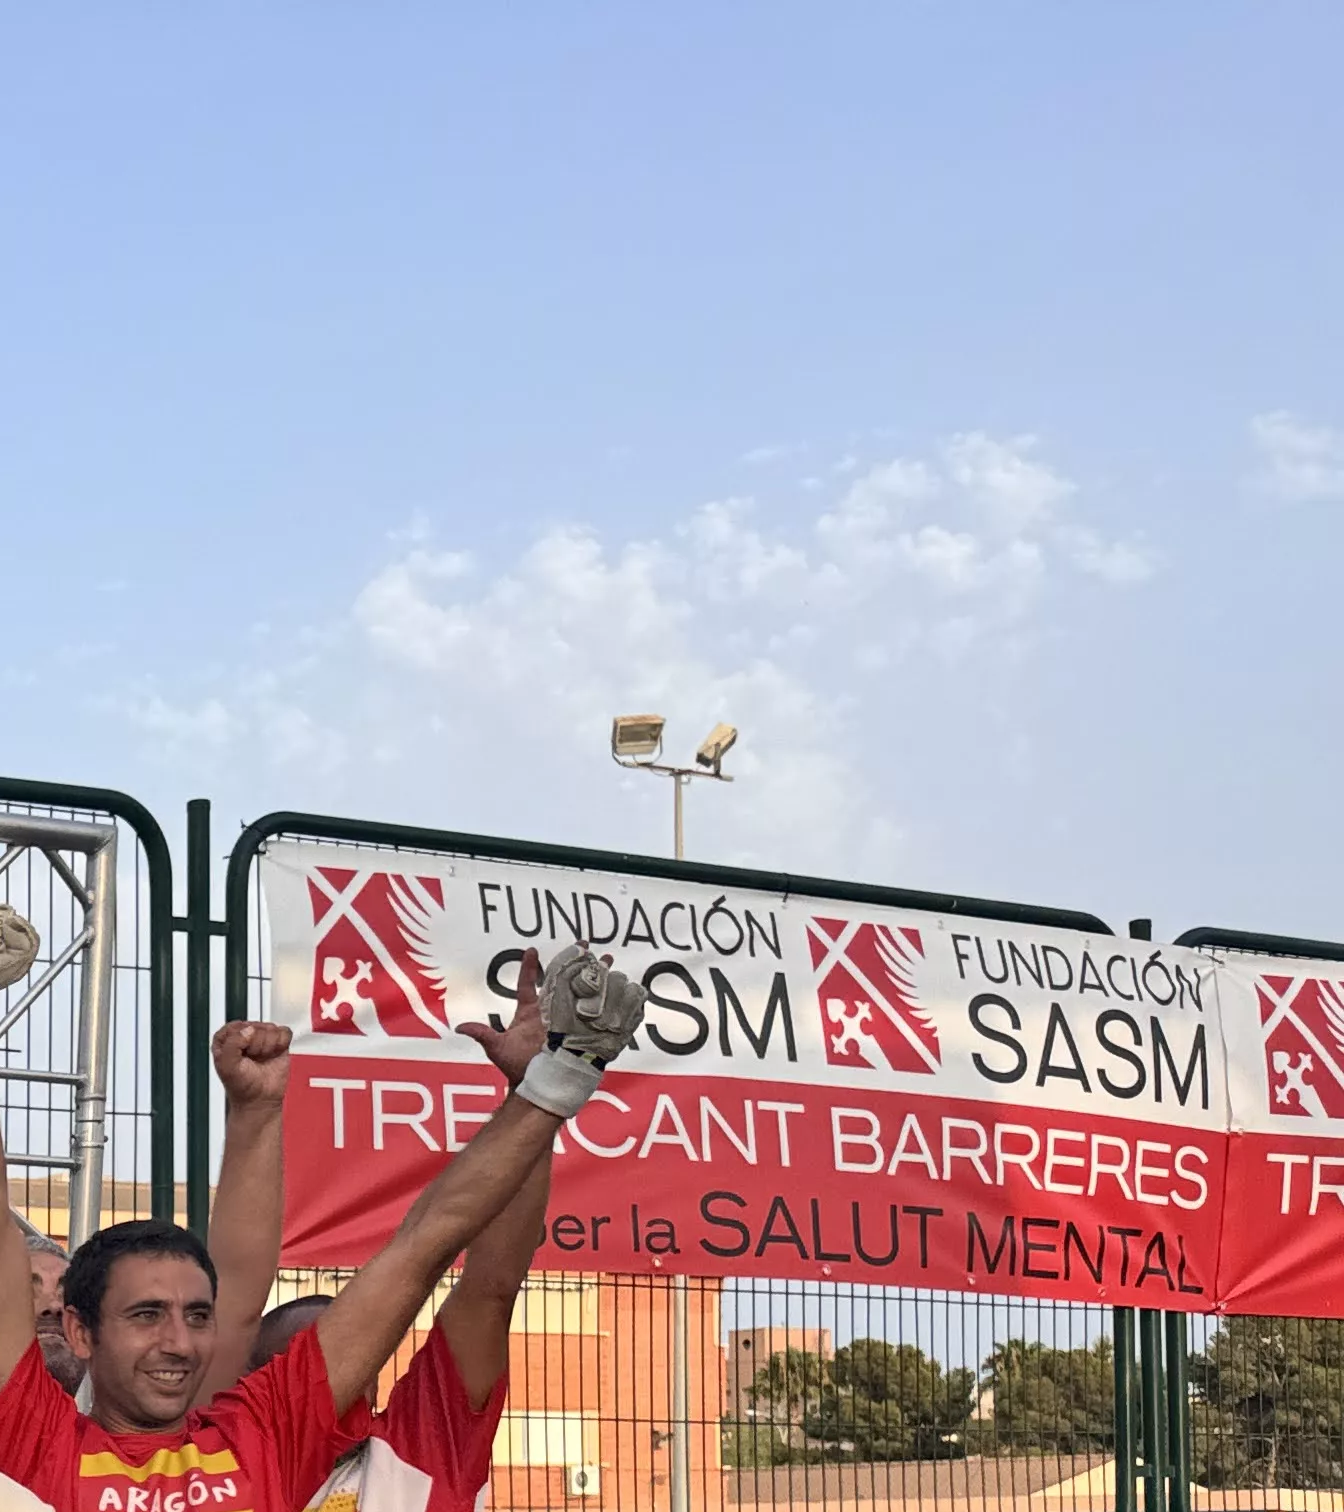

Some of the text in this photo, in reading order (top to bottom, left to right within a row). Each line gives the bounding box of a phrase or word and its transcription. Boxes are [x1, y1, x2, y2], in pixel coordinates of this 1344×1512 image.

[478, 883, 782, 960] FUNDACIÓN
[951, 933, 1204, 1013] FUNDACIÓN
[968, 992, 1210, 1111] SASM
[309, 1078, 805, 1168] TRECANT
[831, 1106, 1209, 1211] BARRERES
[538, 1191, 1205, 1296] er la SALUT MENTAL
